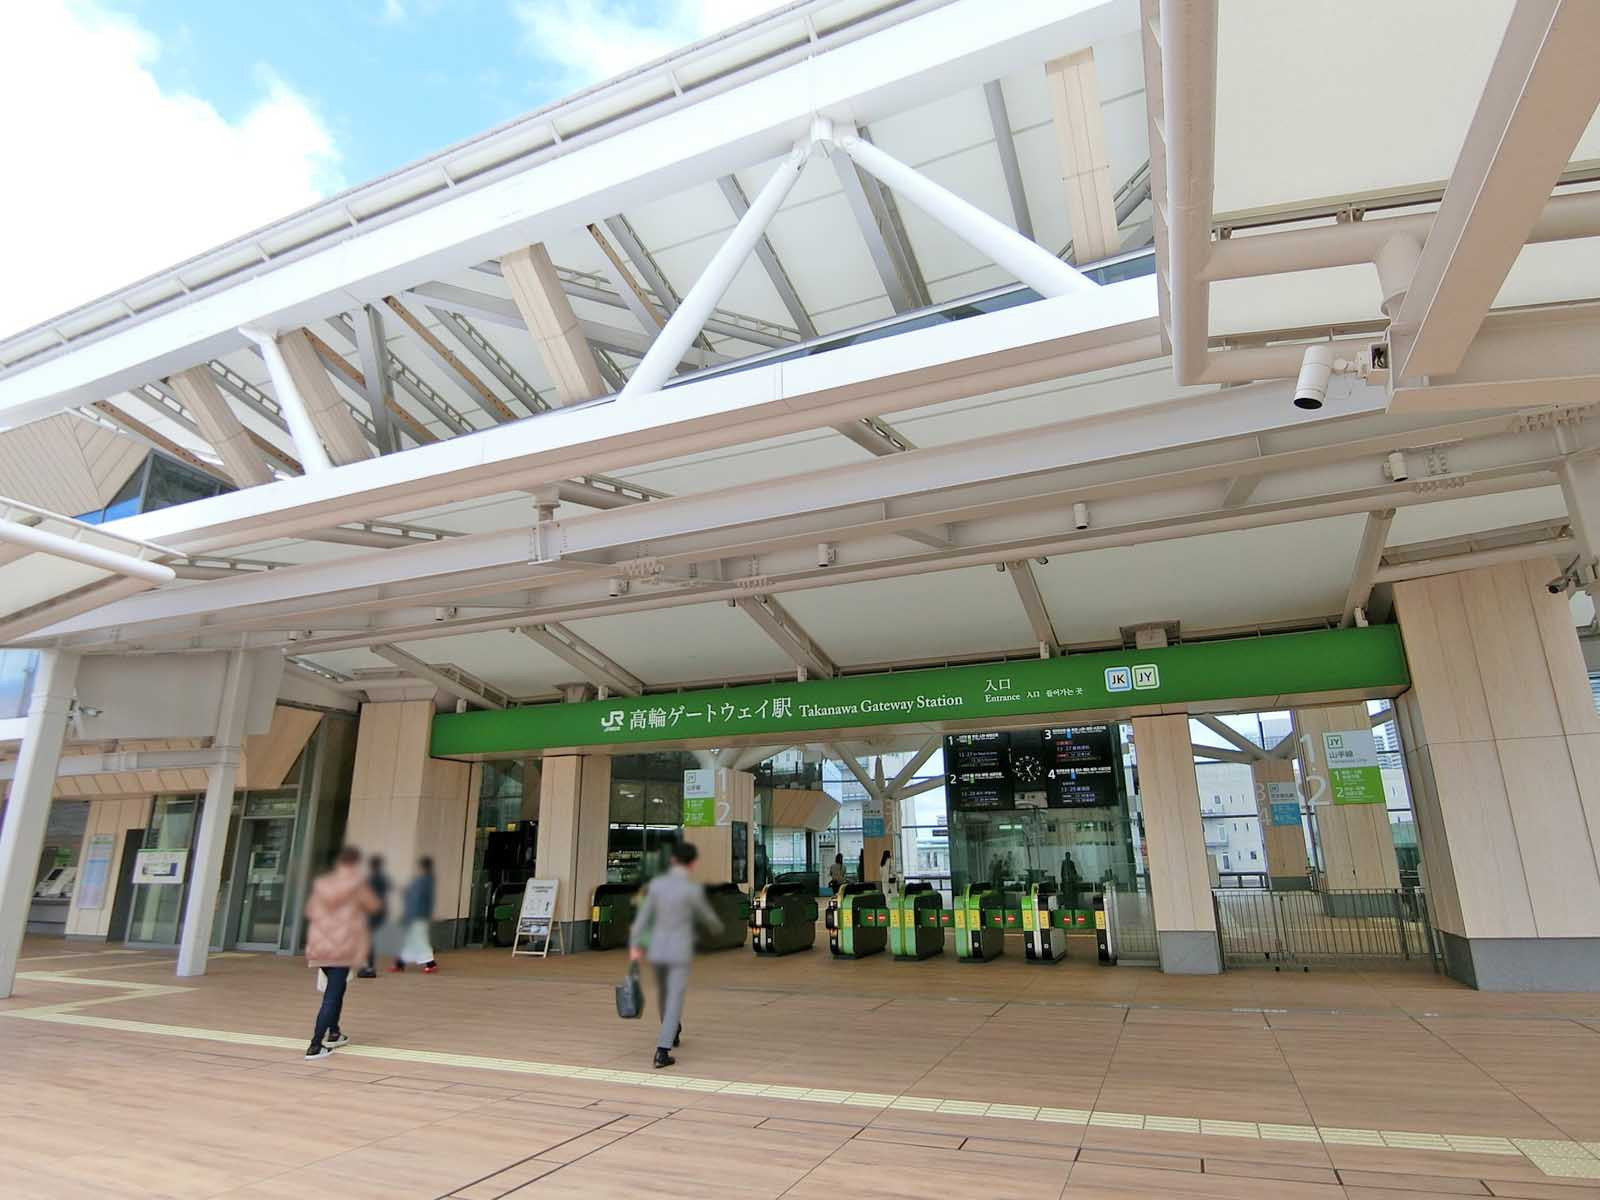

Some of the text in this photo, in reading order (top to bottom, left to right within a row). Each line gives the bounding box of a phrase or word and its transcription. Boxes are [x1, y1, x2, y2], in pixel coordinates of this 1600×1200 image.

[984, 678, 1011, 692] 入口
[984, 693, 1021, 703] Entrance
[1026, 690, 1040, 699] 入口
[799, 694, 963, 718] Takanawa Gateway Station
[600, 710, 625, 727] JR
[629, 697, 793, 730] 高輪ゲートウェイ駅
[948, 735, 954, 746] 1
[1044, 729, 1052, 740] 3
[1301, 733, 1315, 763] 1
[949, 773, 957, 785] 2
[1047, 768, 1056, 780] 4
[1333, 770, 1340, 782] 1
[1335, 786, 1345, 798] 2
